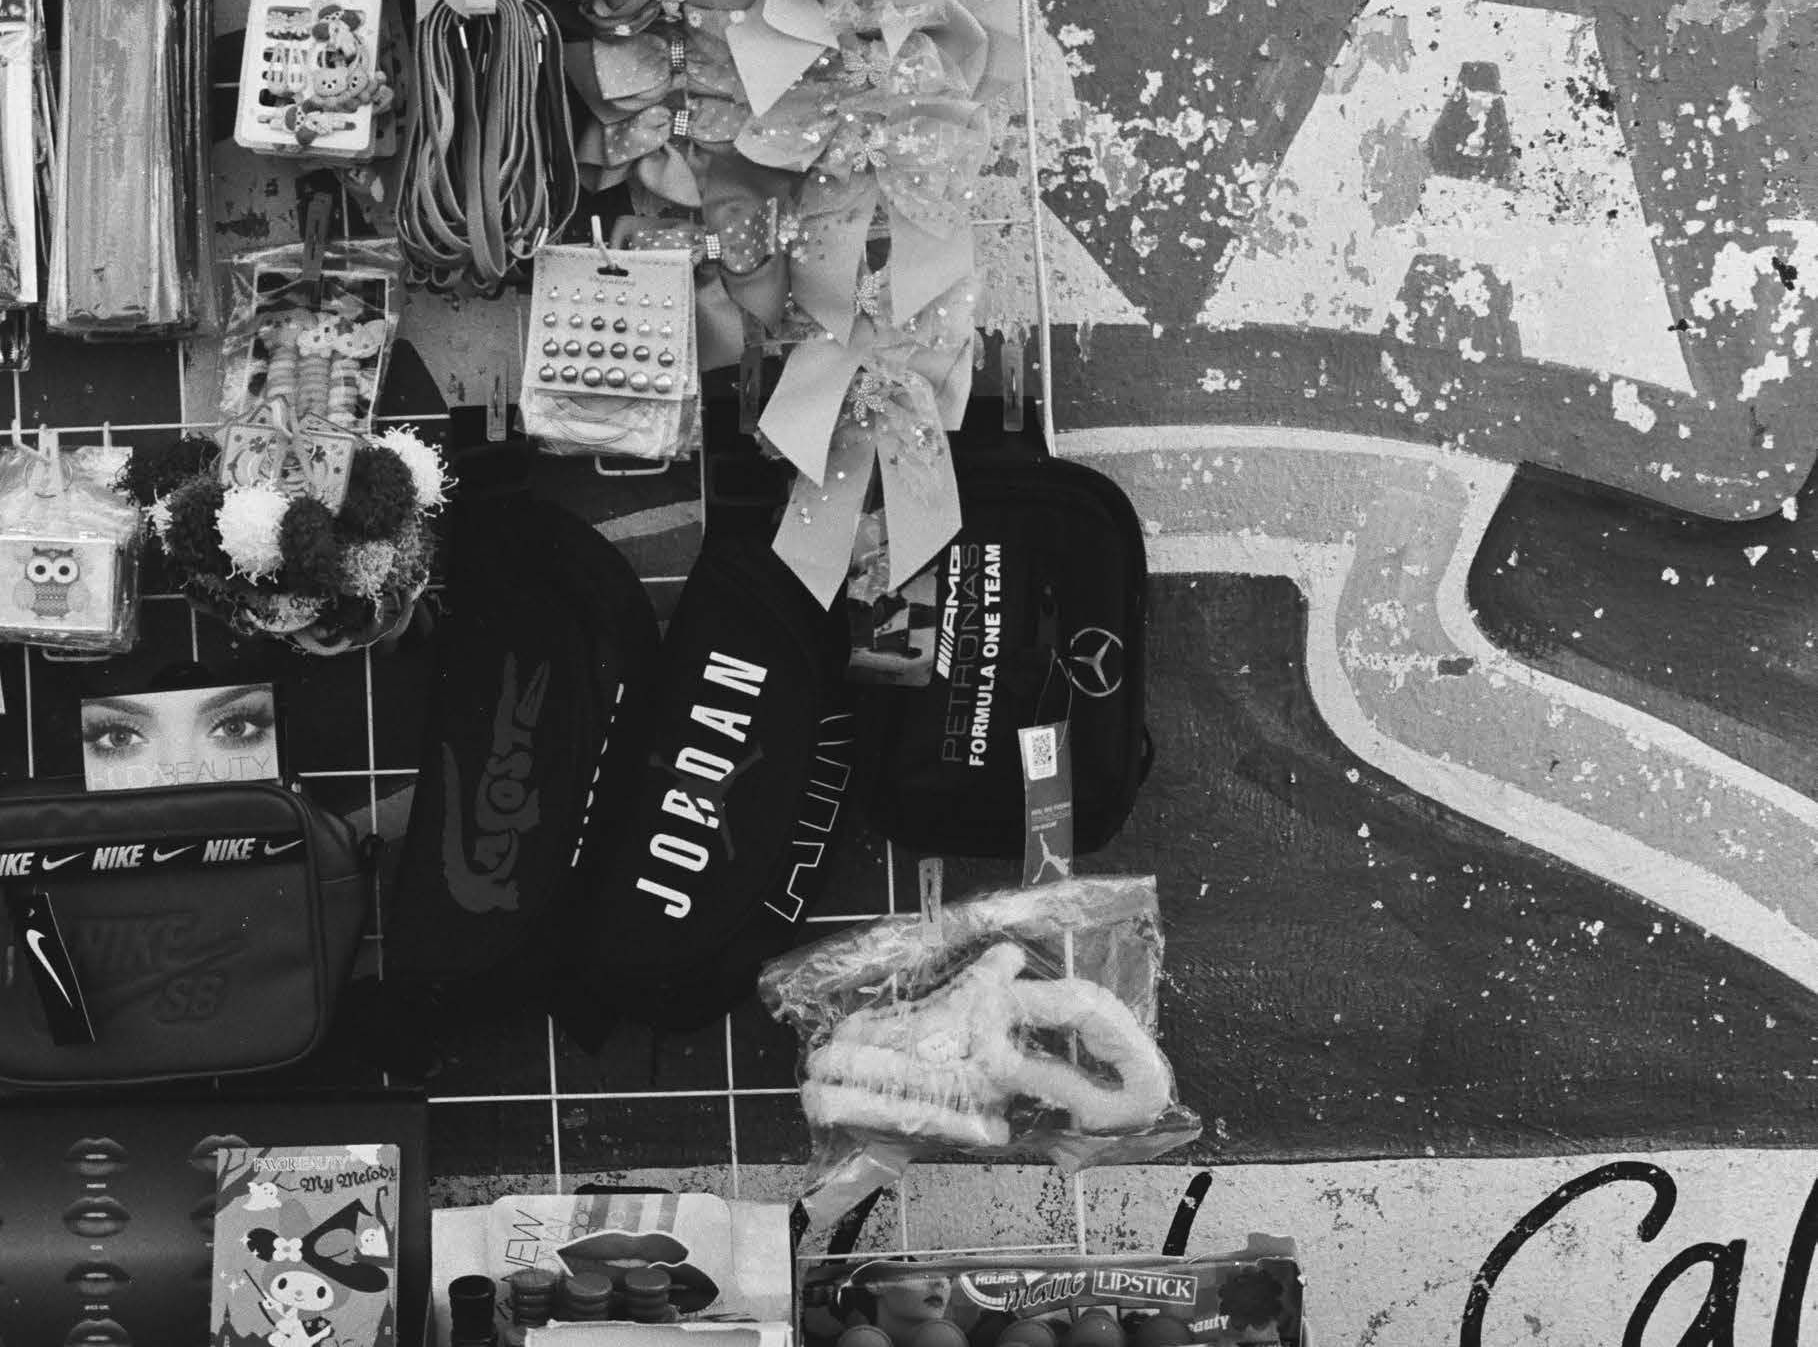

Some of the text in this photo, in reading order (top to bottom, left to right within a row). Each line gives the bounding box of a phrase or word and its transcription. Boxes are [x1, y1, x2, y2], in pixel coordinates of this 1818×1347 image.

[941, 542, 981, 763] PETRONAS
[968, 543, 1002, 767] FORMULA ONE TEAM
[635, 650, 768, 919] JORDAN
[0, 837, 257, 877] IKE NIKE NIKE
[299, 1163, 398, 1195] My Melody
[1097, 1270, 1192, 1299] LIPSTICK
